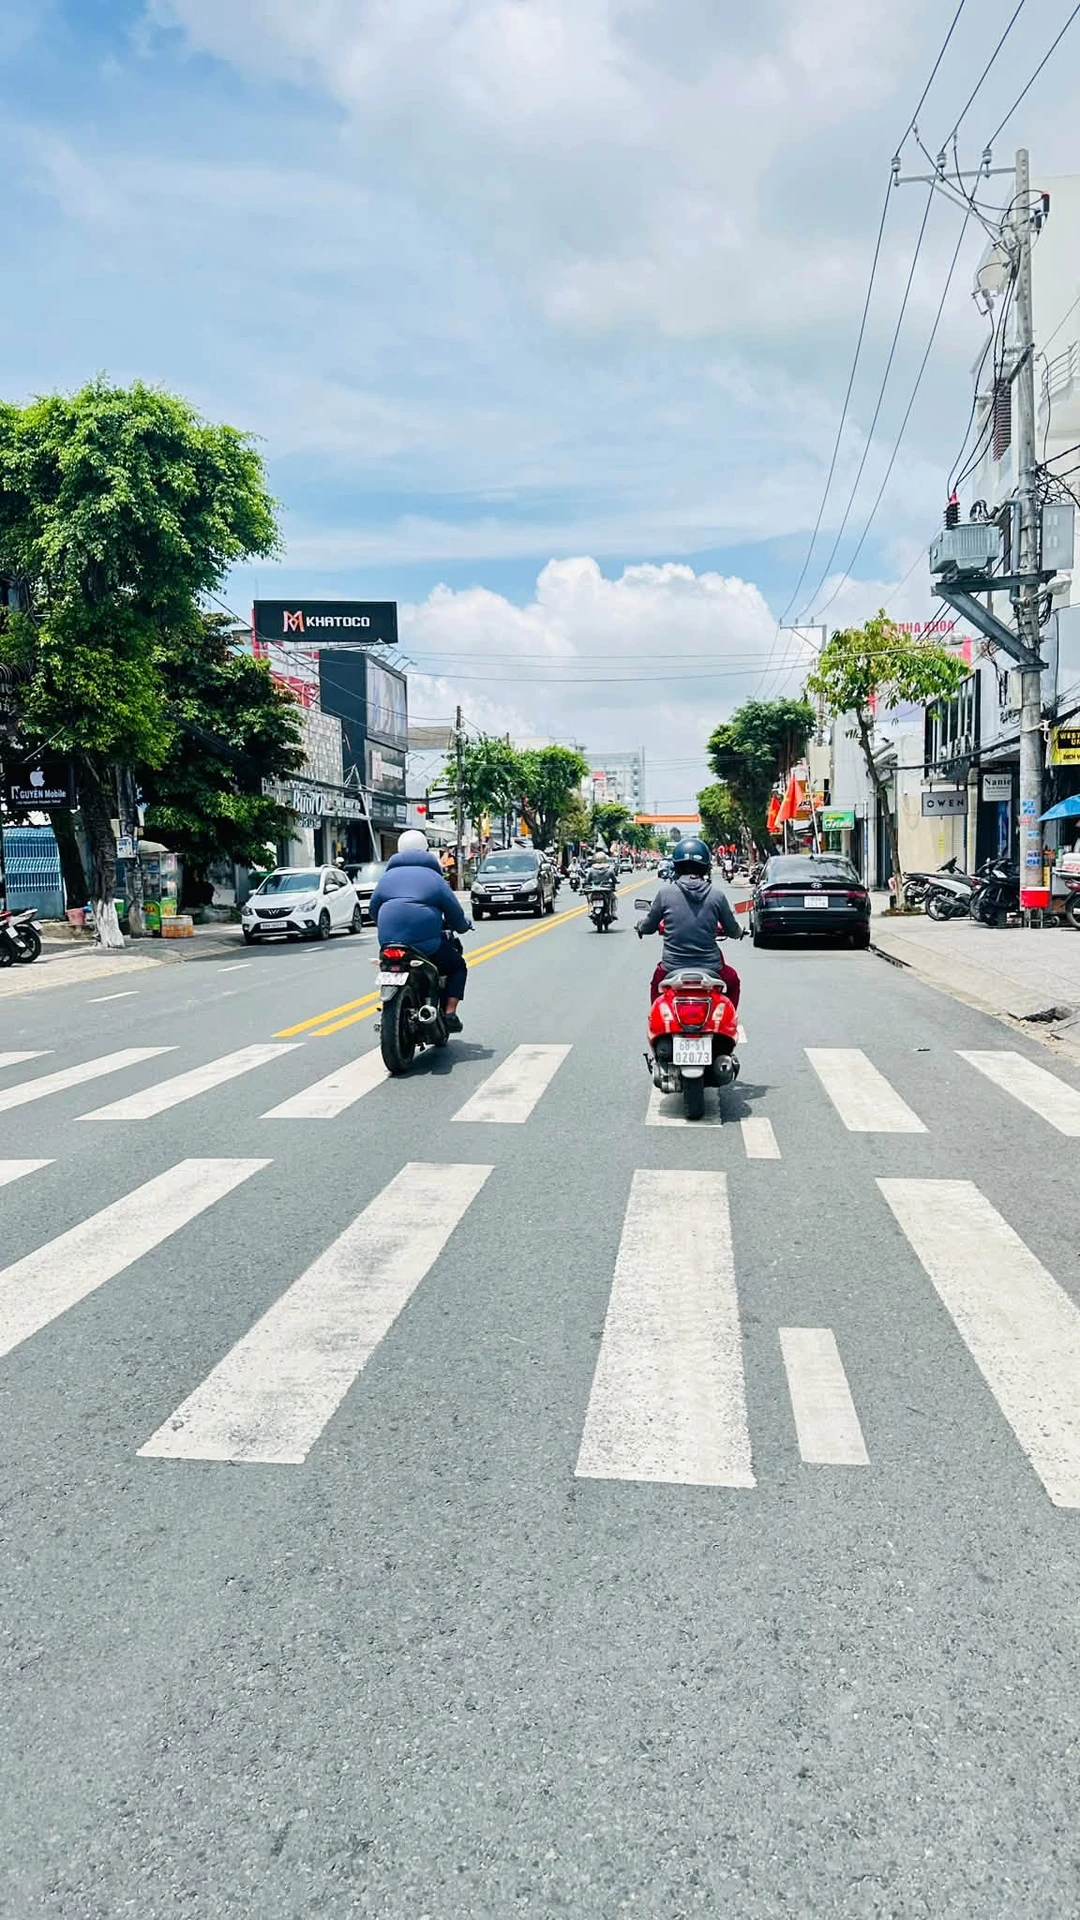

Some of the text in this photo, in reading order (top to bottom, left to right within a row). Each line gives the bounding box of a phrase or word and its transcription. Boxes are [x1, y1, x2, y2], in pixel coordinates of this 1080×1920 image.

[306, 616, 370, 628] KHATOCO
[44, 789, 67, 798] Mobile
[926, 798, 964, 808] OWEN
